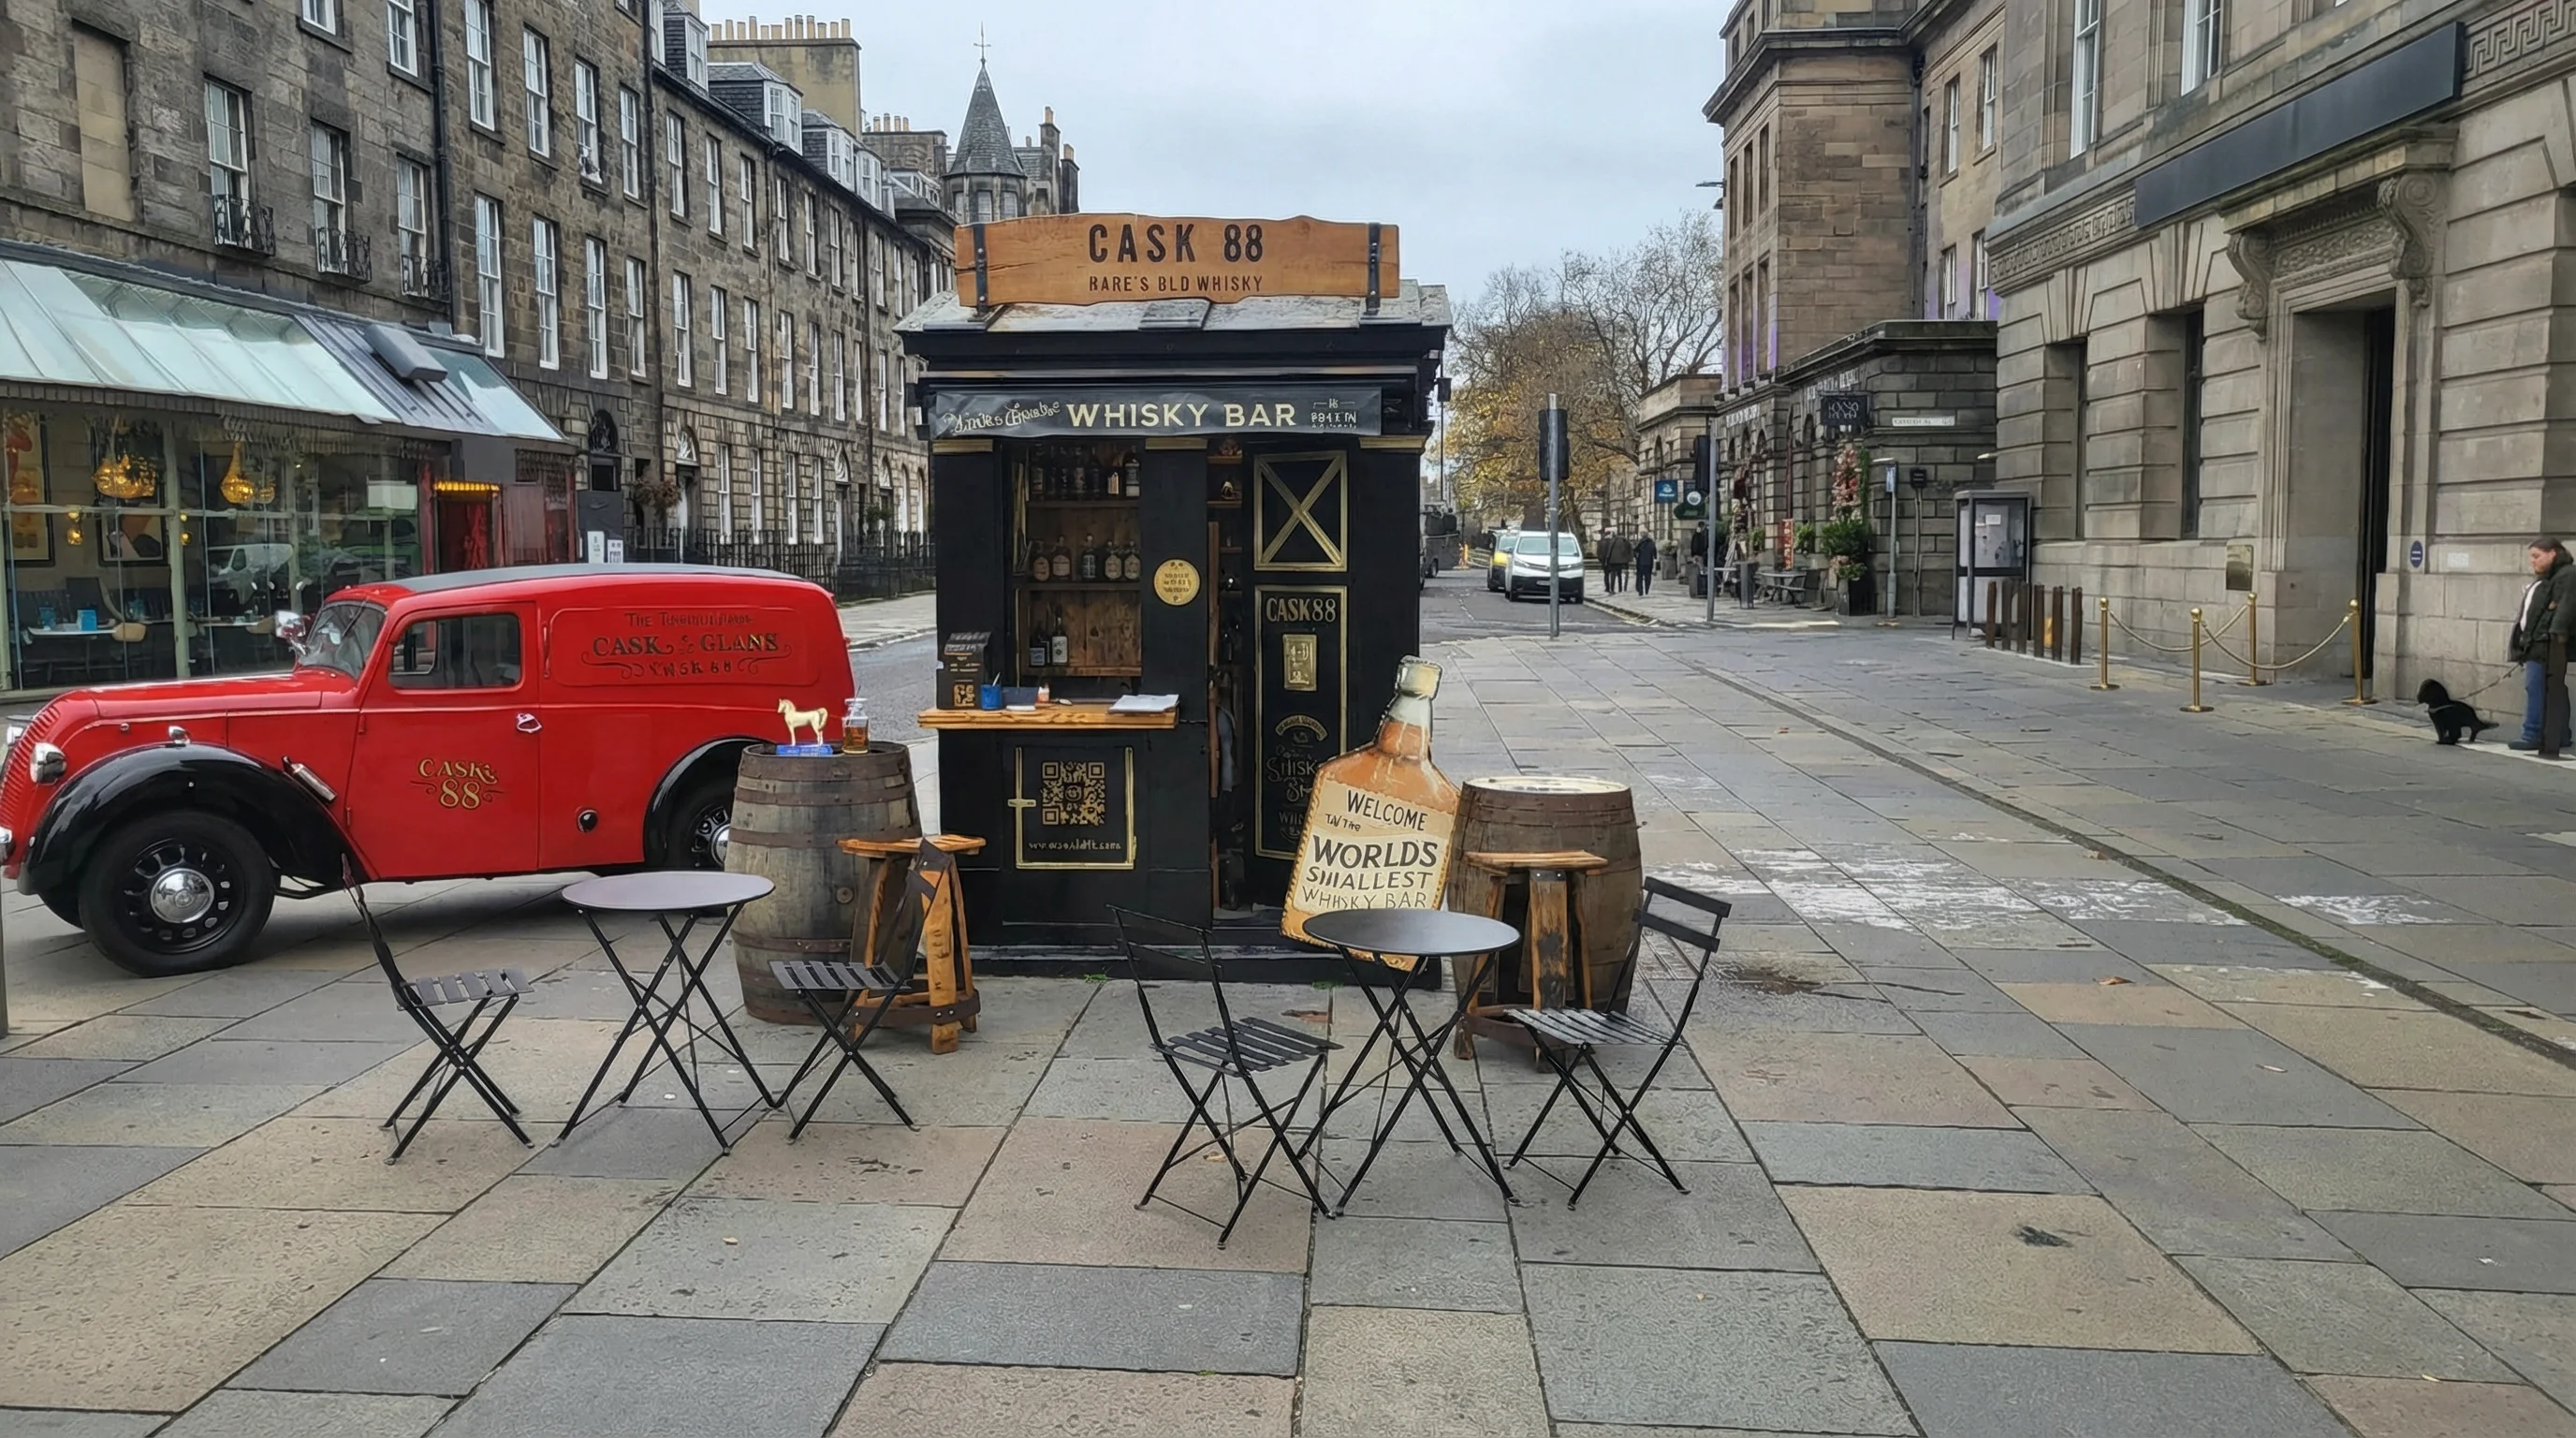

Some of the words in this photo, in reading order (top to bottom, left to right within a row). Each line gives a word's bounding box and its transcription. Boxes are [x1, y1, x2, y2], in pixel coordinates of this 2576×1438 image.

[1089, 224, 1196, 263] CASK
[1223, 224, 1263, 263] 88
[1196, 275, 1263, 292] WHISKY
[1066, 404, 1209, 428] WHISKY
[1223, 404, 1297, 428] BAR
[593, 636, 674, 656] CASK
[440, 778, 480, 809] 88
[1347, 789, 1428, 830] WELCOME
[1385, 891, 1427, 908] BAR
